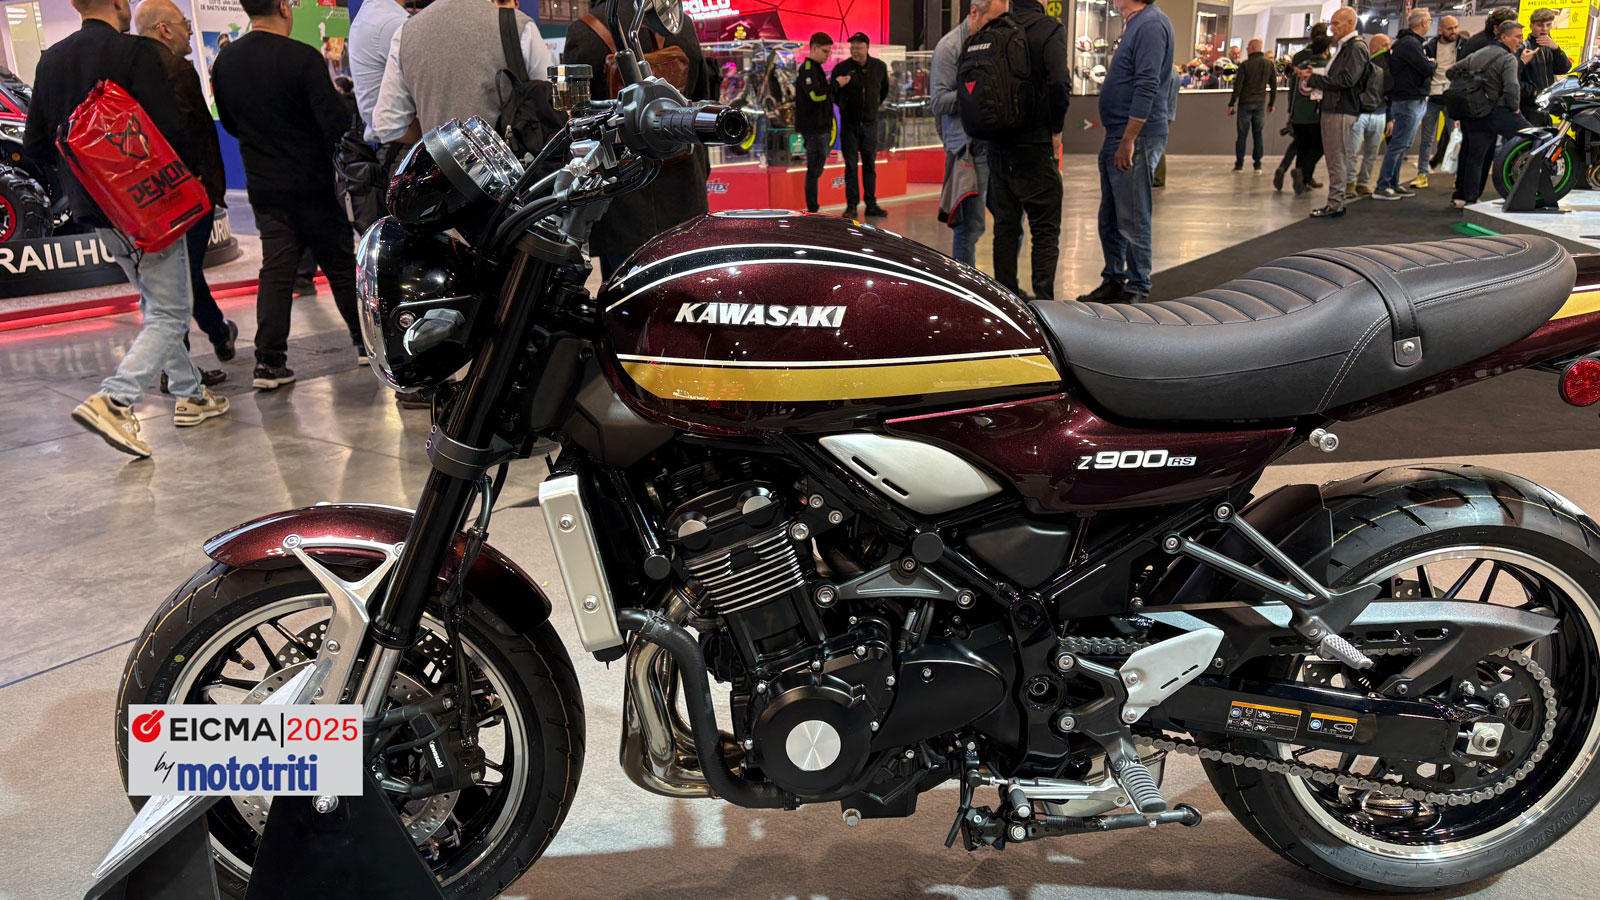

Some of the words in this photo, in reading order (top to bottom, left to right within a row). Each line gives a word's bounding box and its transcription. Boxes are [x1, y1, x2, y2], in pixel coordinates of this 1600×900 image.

[682, 0, 731, 13] POLLO
[0, 239, 117, 274] RAILHU
[673, 301, 848, 328] KAWASAKI
[1169, 456, 1194, 467] RS
